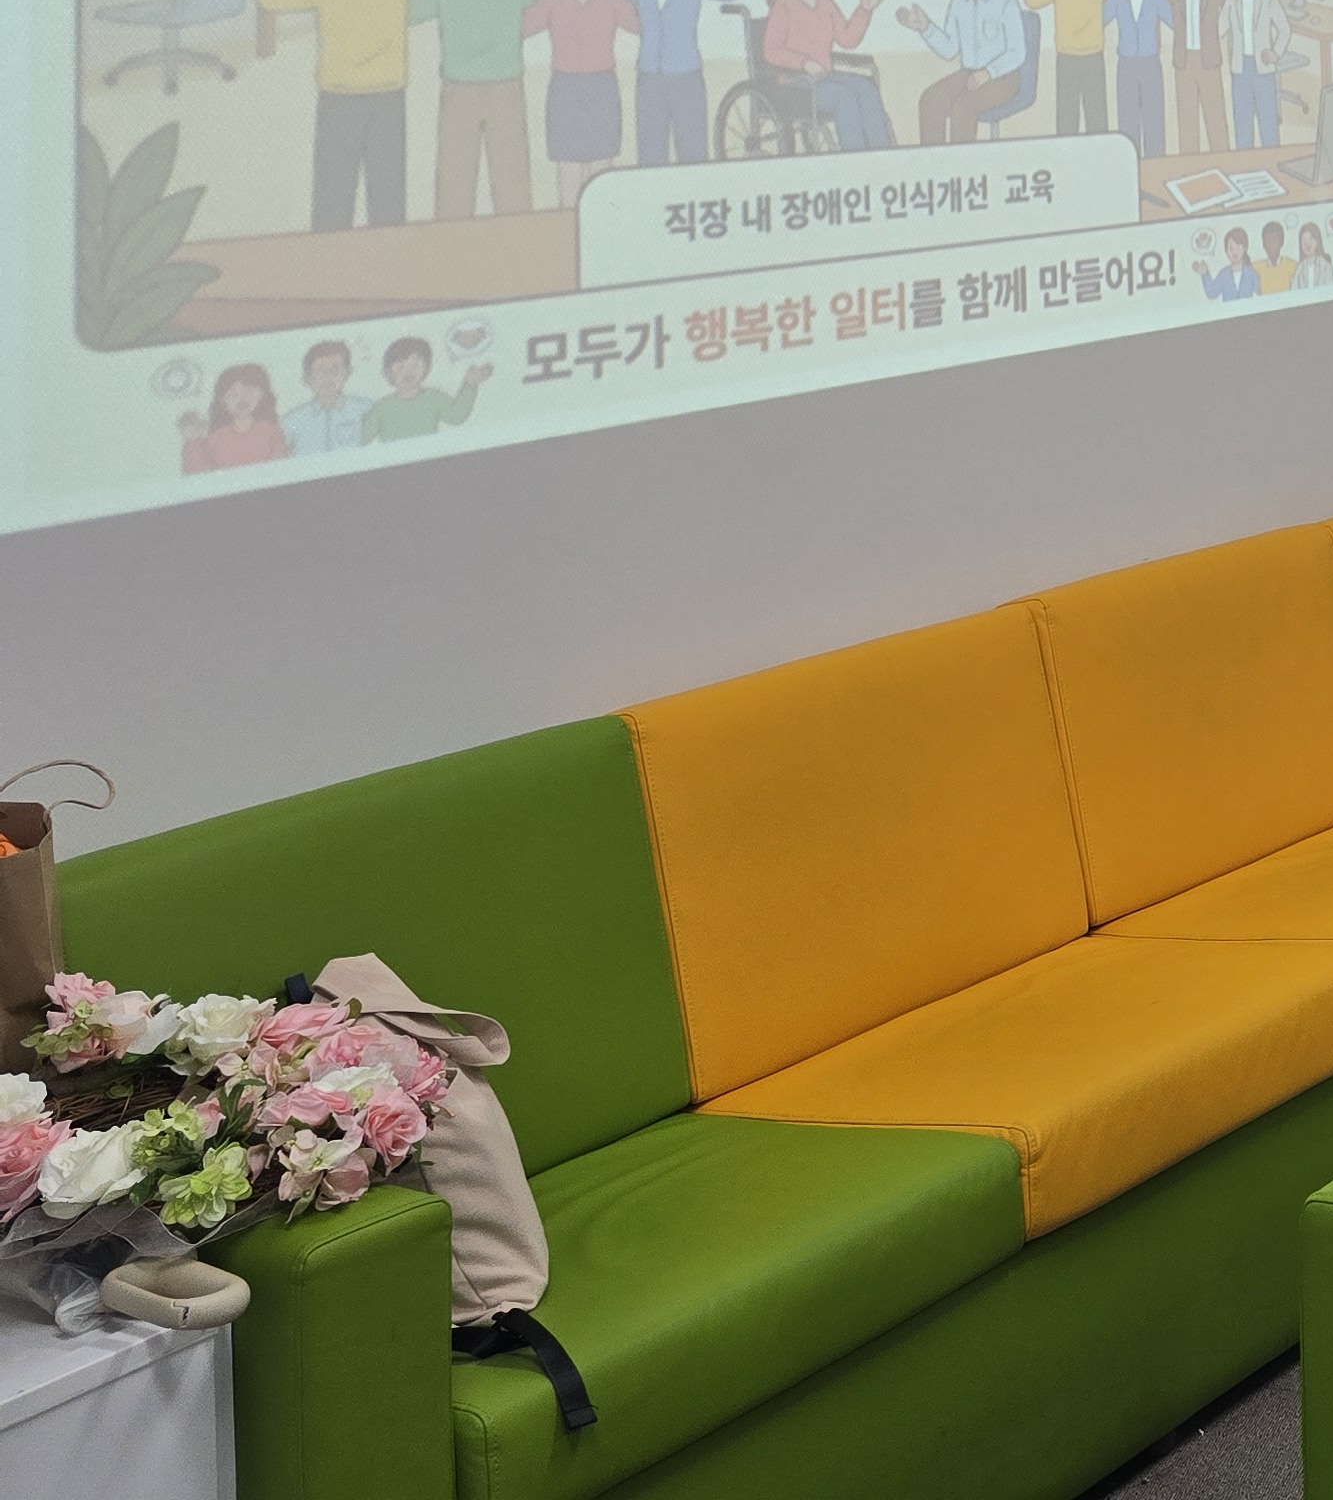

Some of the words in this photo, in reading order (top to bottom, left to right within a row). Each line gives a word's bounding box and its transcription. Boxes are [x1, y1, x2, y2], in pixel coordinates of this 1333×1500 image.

[665, 198, 731, 242] 직장
[741, 194, 772, 233] 내
[782, 185, 871, 230] 장애인
[881, 174, 988, 219] 인식개선
[1004, 169, 1055, 205] 교육
[522, 314, 671, 384] 모두가
[684, 295, 816, 362] 행복한
[829, 278, 946, 341] 일터를
[957, 265, 1028, 321] 함께
[1039, 249, 1176, 309] 만들어요!
